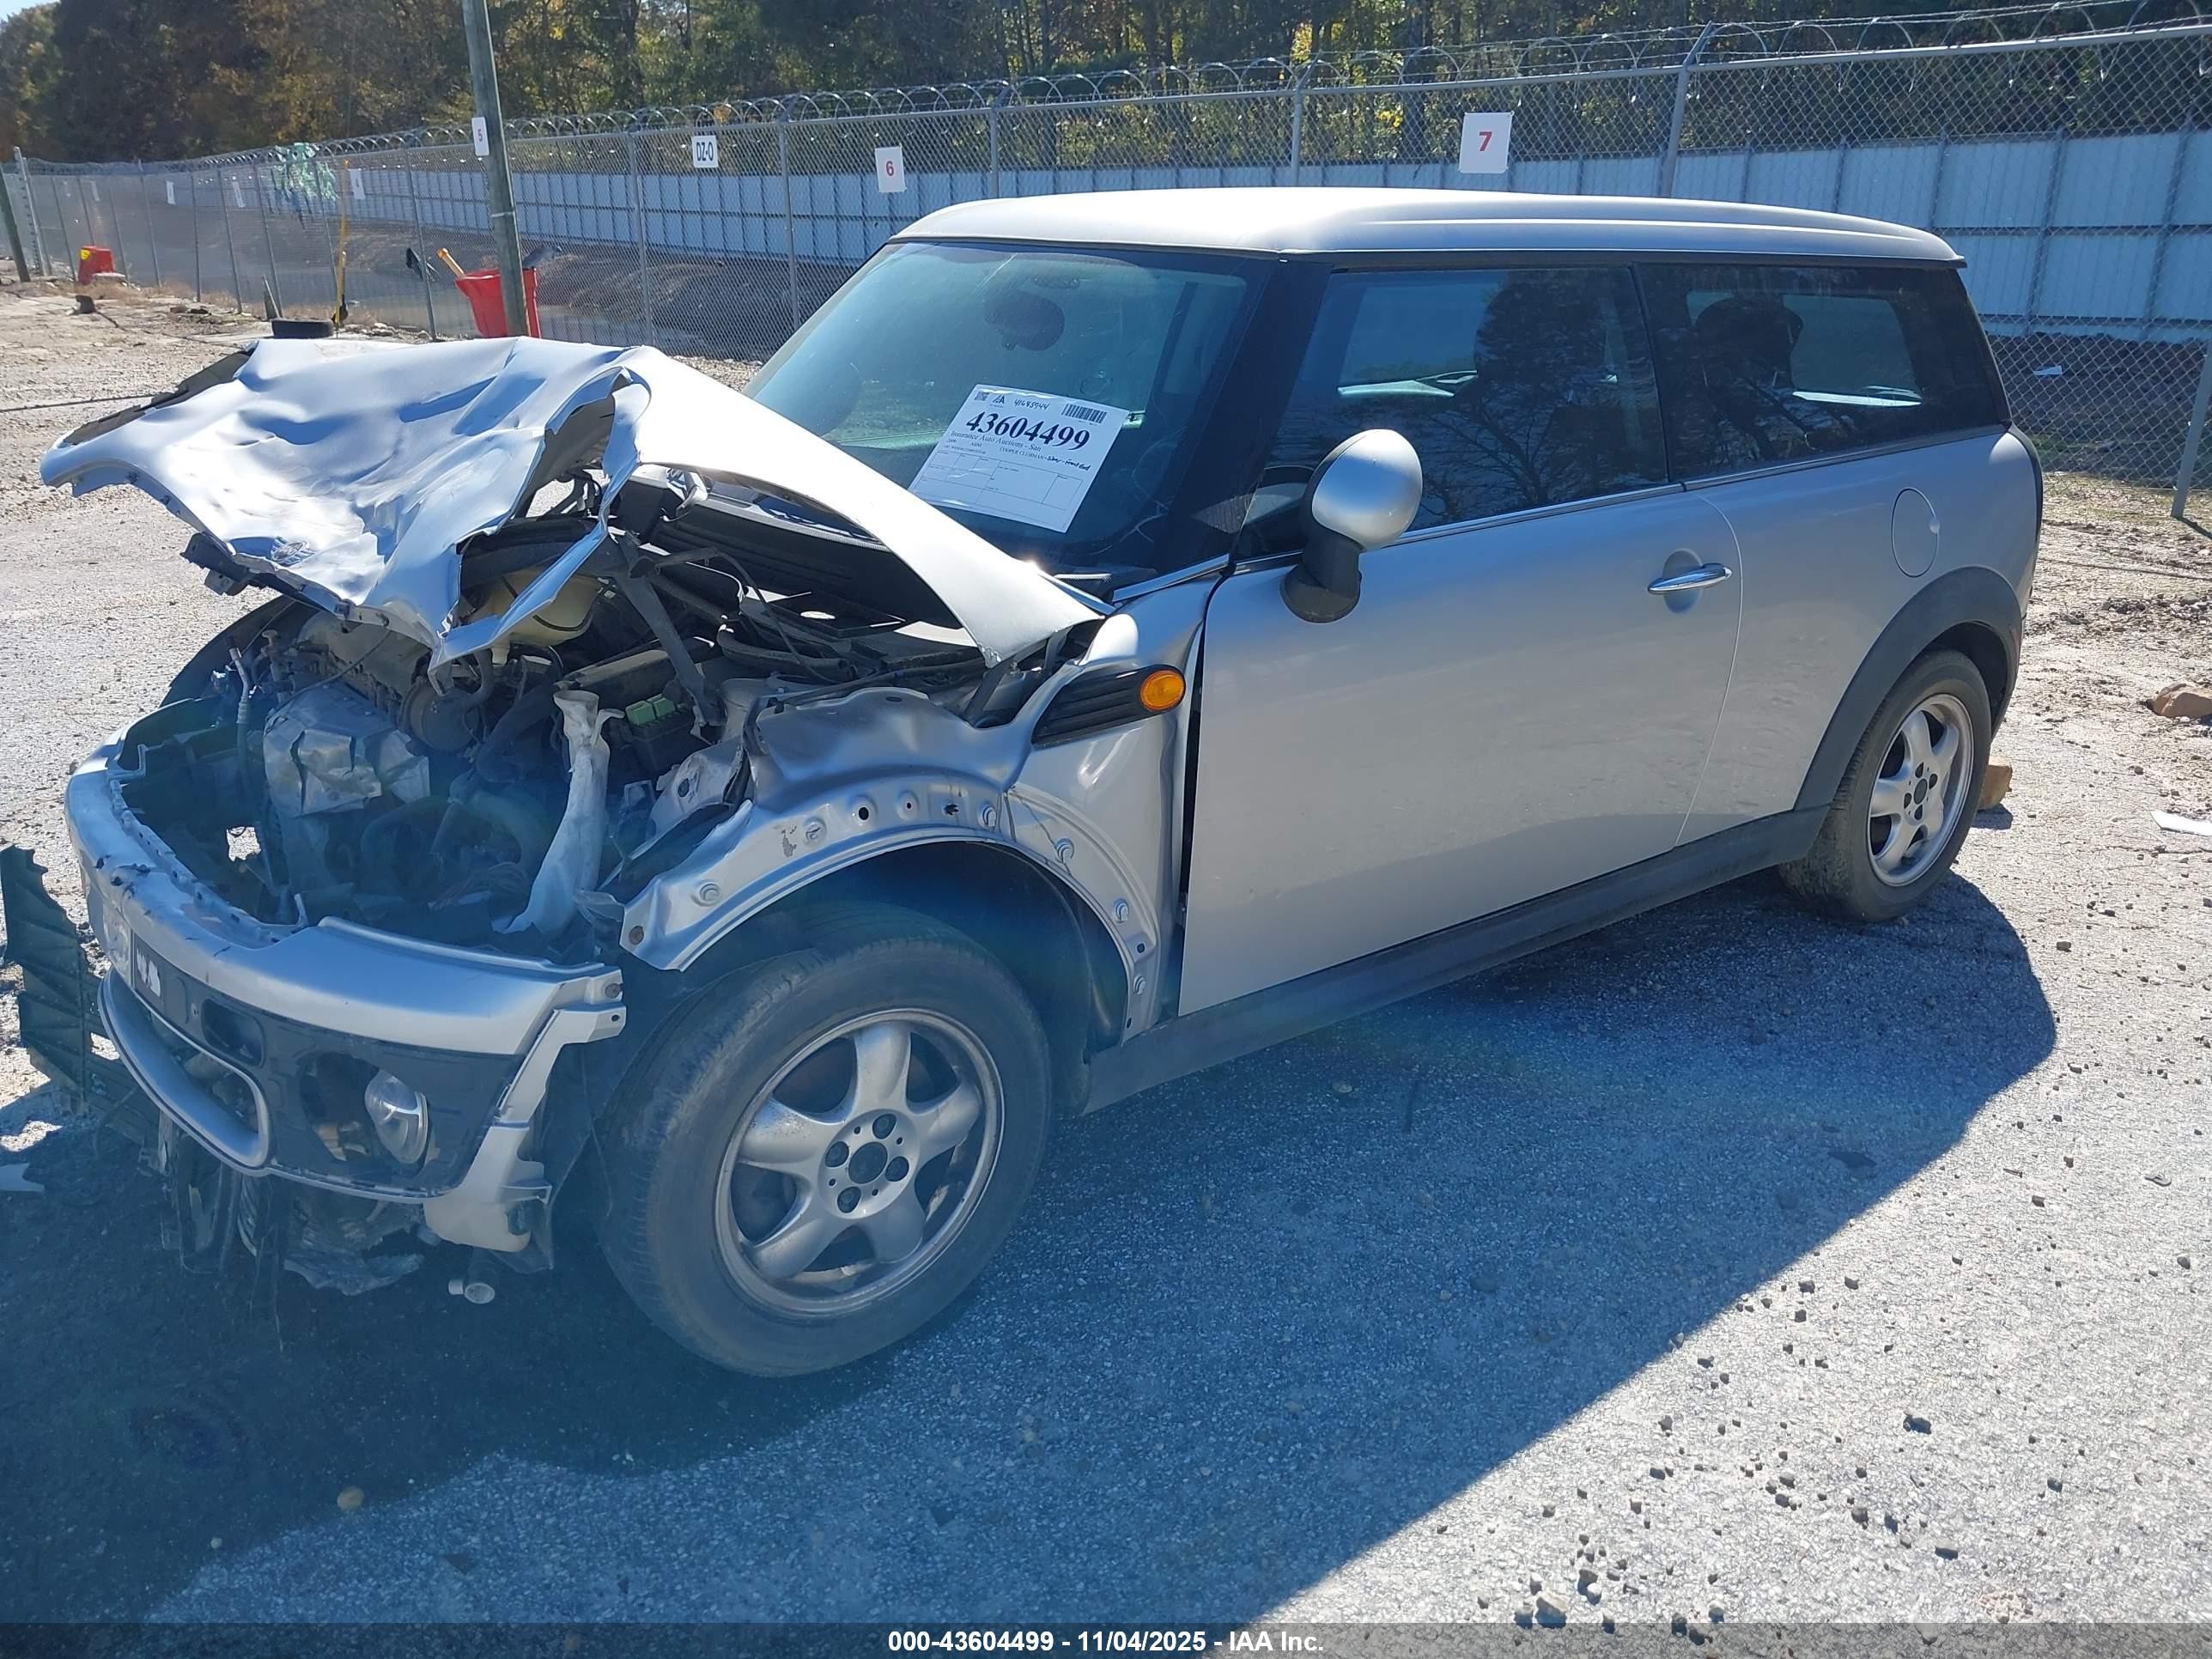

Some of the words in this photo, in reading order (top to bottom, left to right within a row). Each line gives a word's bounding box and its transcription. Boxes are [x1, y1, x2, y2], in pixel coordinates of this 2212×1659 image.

[1479, 131, 1492, 152] 7
[885, 160, 895, 177] 6
[950, 430, 978, 440] Insurance
[995, 438, 1024, 448] Auctions
[966, 411, 1090, 451] 43604499
